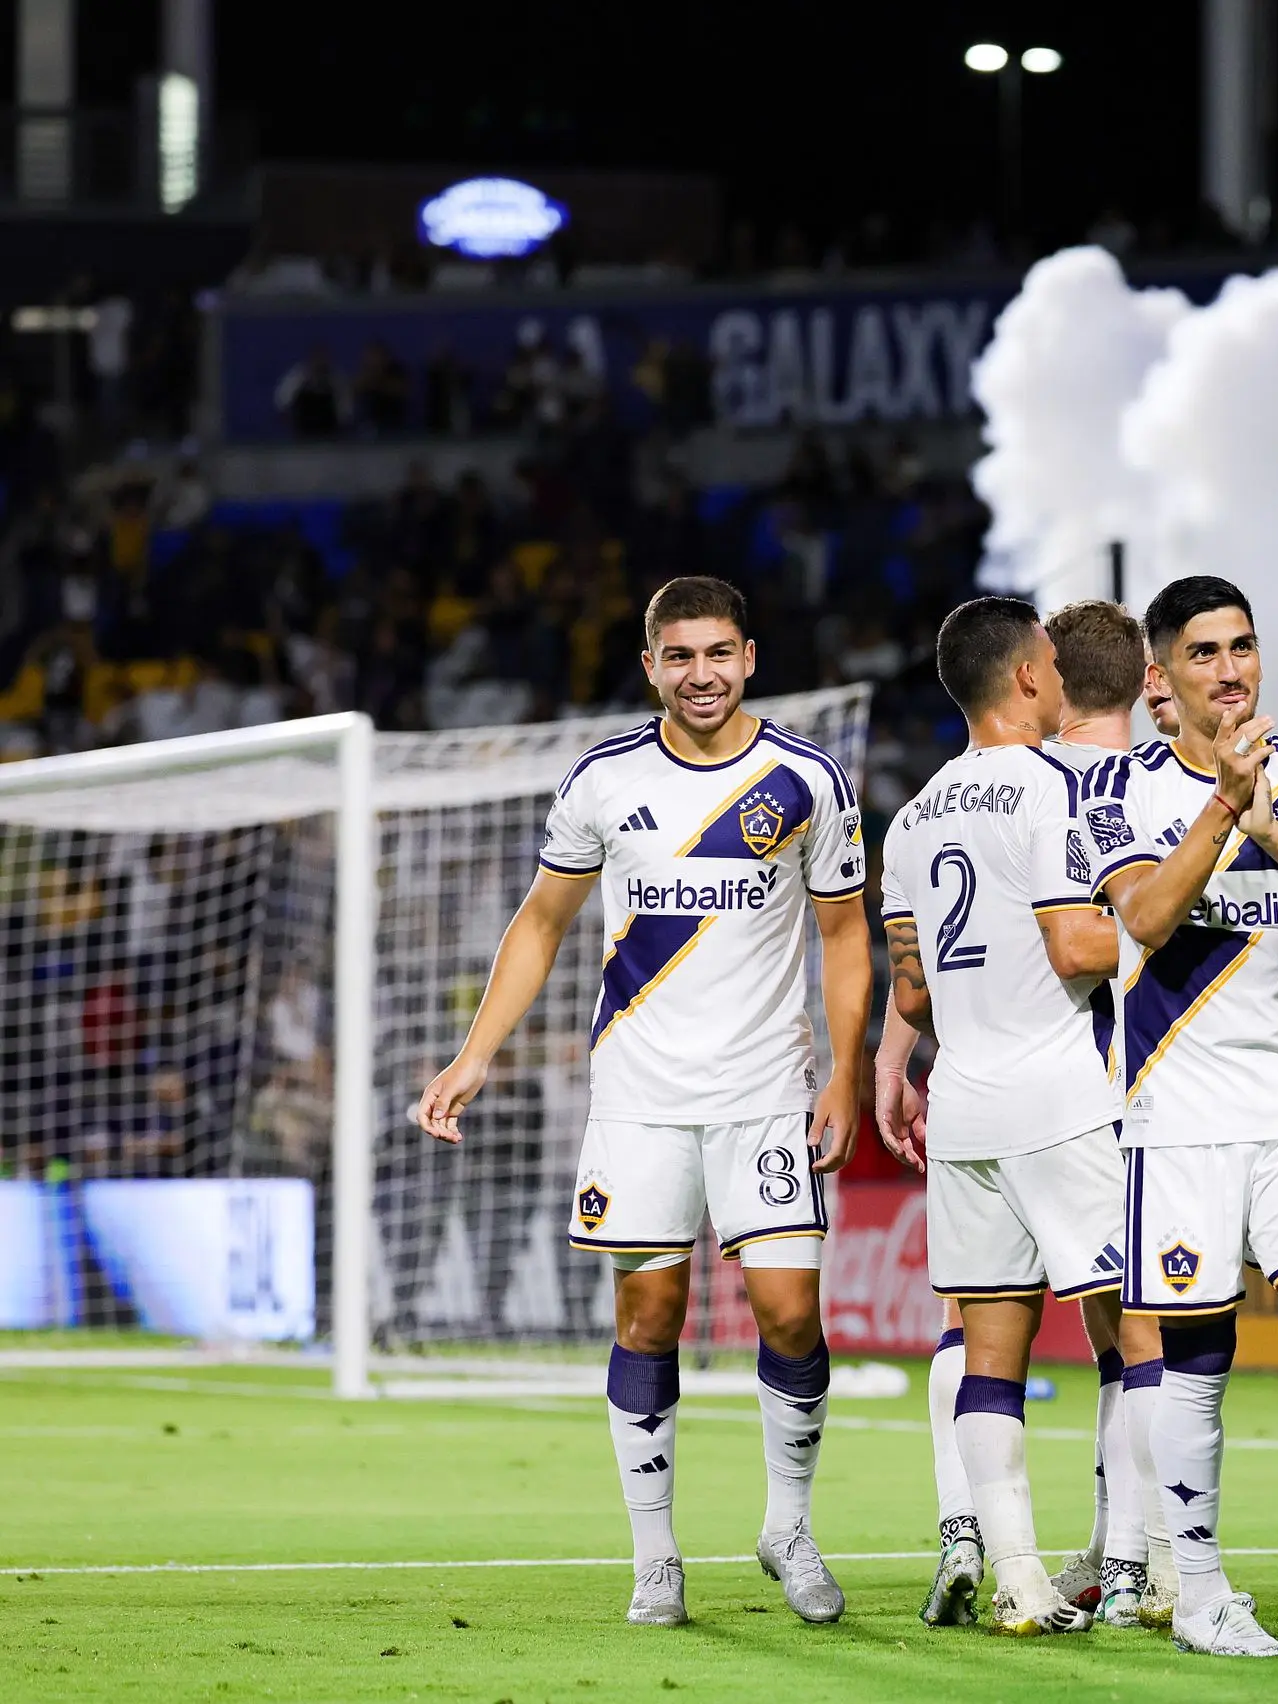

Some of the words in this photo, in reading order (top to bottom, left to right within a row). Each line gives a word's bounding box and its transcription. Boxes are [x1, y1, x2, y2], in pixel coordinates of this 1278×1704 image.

[709, 298, 990, 427] GALAXY
[902, 782, 1025, 831] CALEGARI
[748, 819, 773, 836] LA
[846, 815, 859, 827] MLS
[1100, 832, 1132, 853] RBC
[627, 878, 767, 911] Herbalife
[930, 842, 988, 973] 2
[757, 1146, 801, 1208] 8
[582, 1199, 602, 1215] LA
[1167, 1260, 1193, 1275] LA
